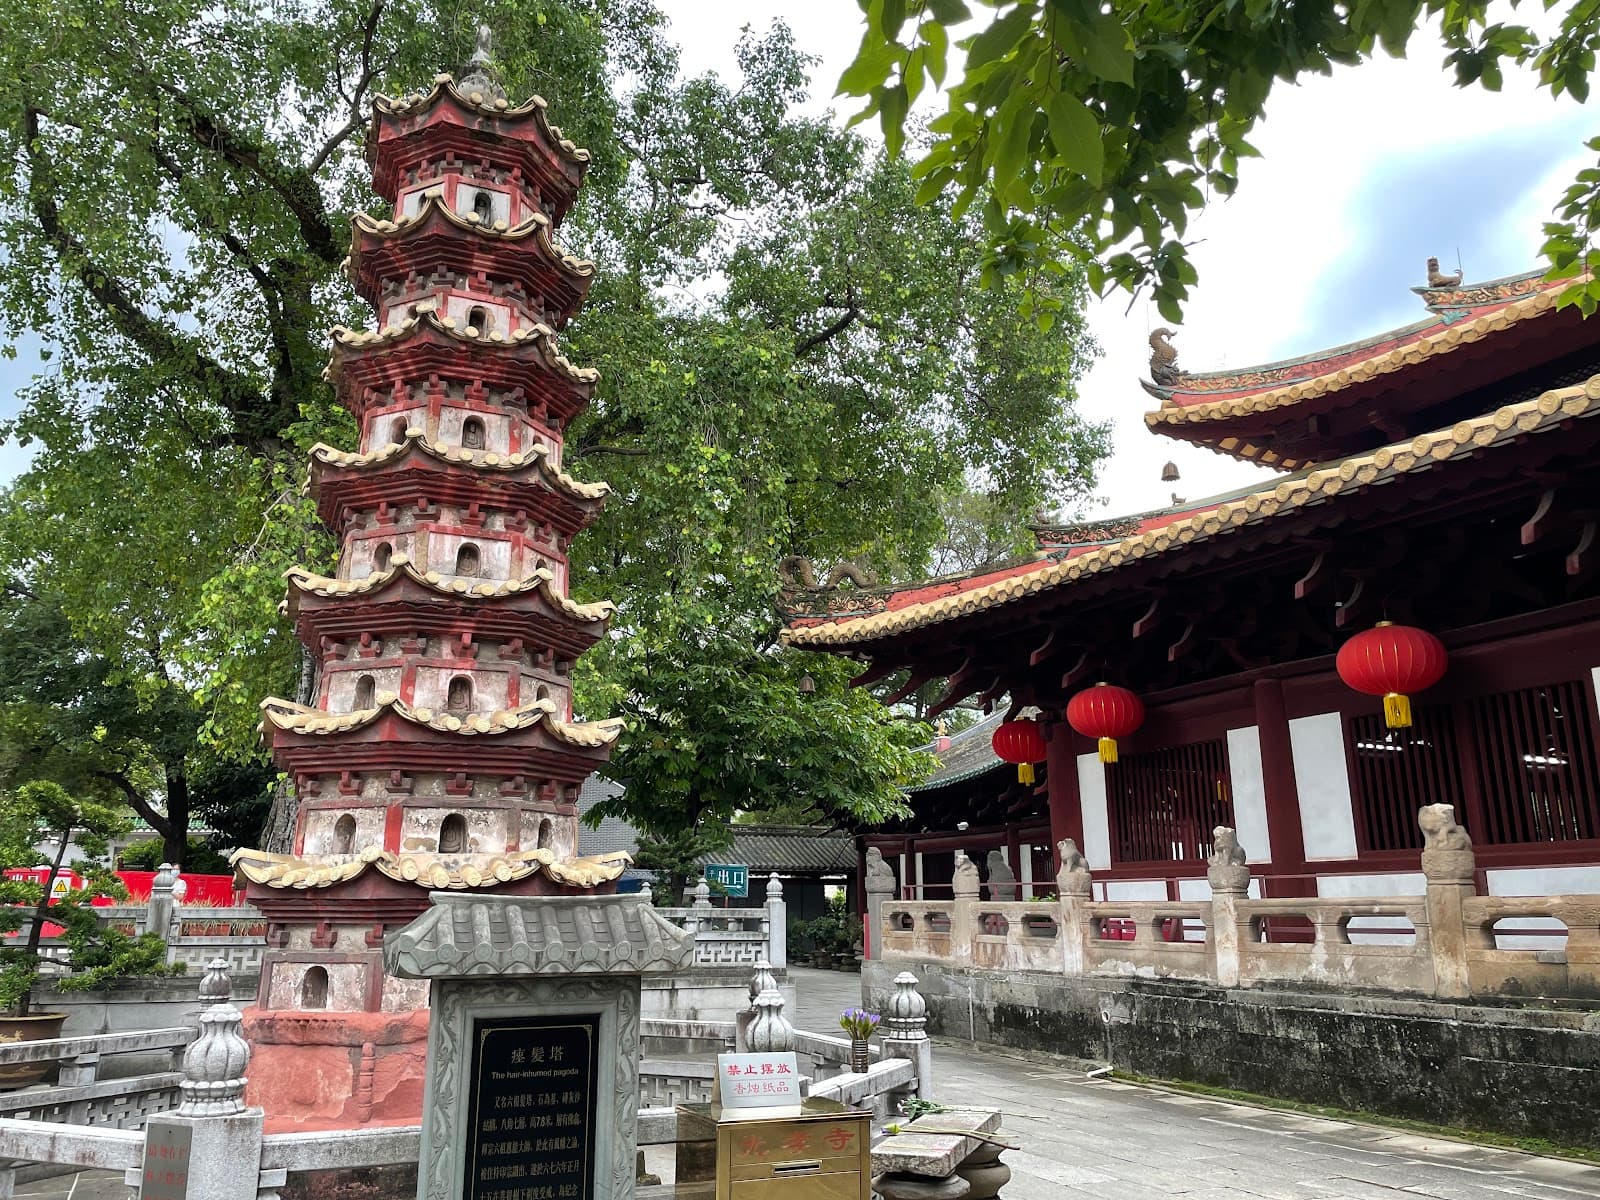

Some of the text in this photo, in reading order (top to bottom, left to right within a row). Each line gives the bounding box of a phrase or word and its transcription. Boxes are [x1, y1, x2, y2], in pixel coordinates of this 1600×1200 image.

[718, 869, 744, 885] 出口
[491, 1067, 579, 1080] The hair-inhumed pagoda
[727, 1063, 791, 1076] 禁止摆放
[734, 1081, 789, 1095] 香烛纸品
